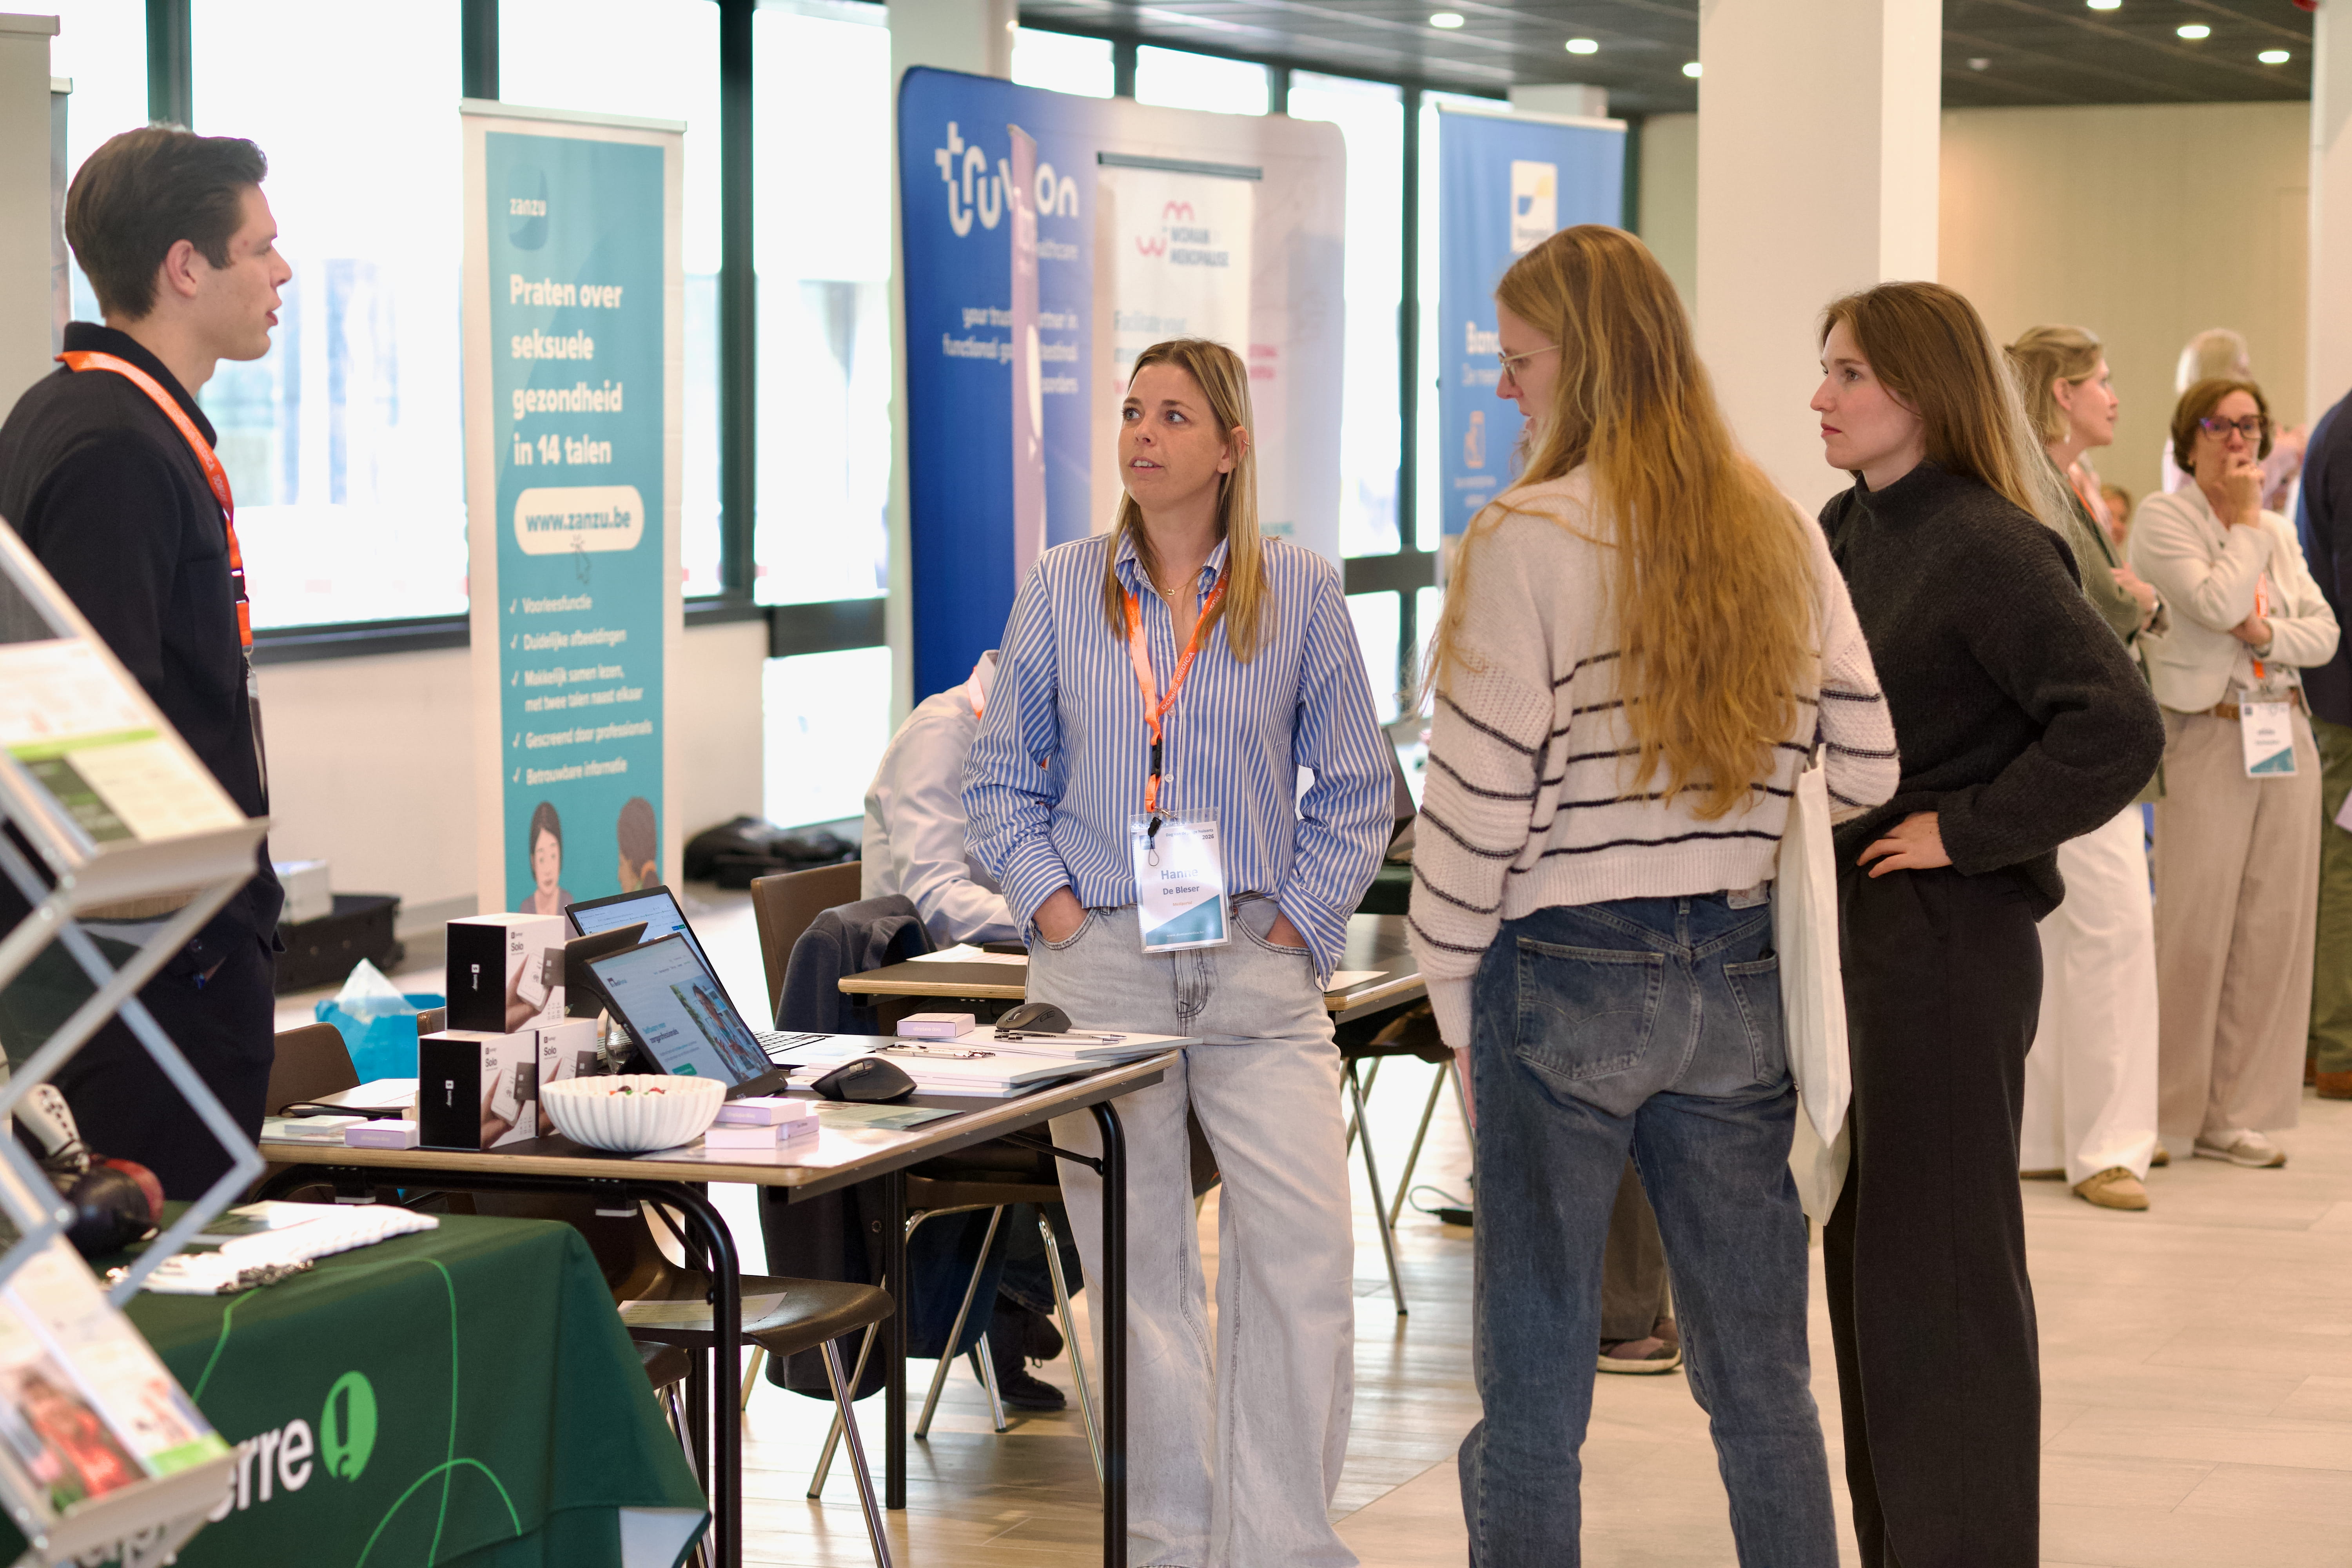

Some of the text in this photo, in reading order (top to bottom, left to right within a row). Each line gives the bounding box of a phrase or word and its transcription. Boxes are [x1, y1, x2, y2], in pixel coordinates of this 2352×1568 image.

[510, 198, 546, 216] zanzu
[510, 274, 623, 309] Praten over
[512, 328, 594, 360] seksuele
[942, 332, 998, 359] functional
[513, 379, 622, 421] gezondheid
[514, 432, 612, 466] in 14 talen
[526, 505, 631, 532] www.zanzu.be
[1209, 588, 1224, 612] EDICA
[523, 630, 568, 652] Duidelijke
[1161, 652, 1195, 710] DOMUS MEDICA
[595, 718, 653, 744] professionals
[1161, 869, 1198, 880] Hanne
[511, 942, 524, 952] Solo
[485, 1057, 497, 1067] Solo
[544, 1045, 557, 1056] Solo
